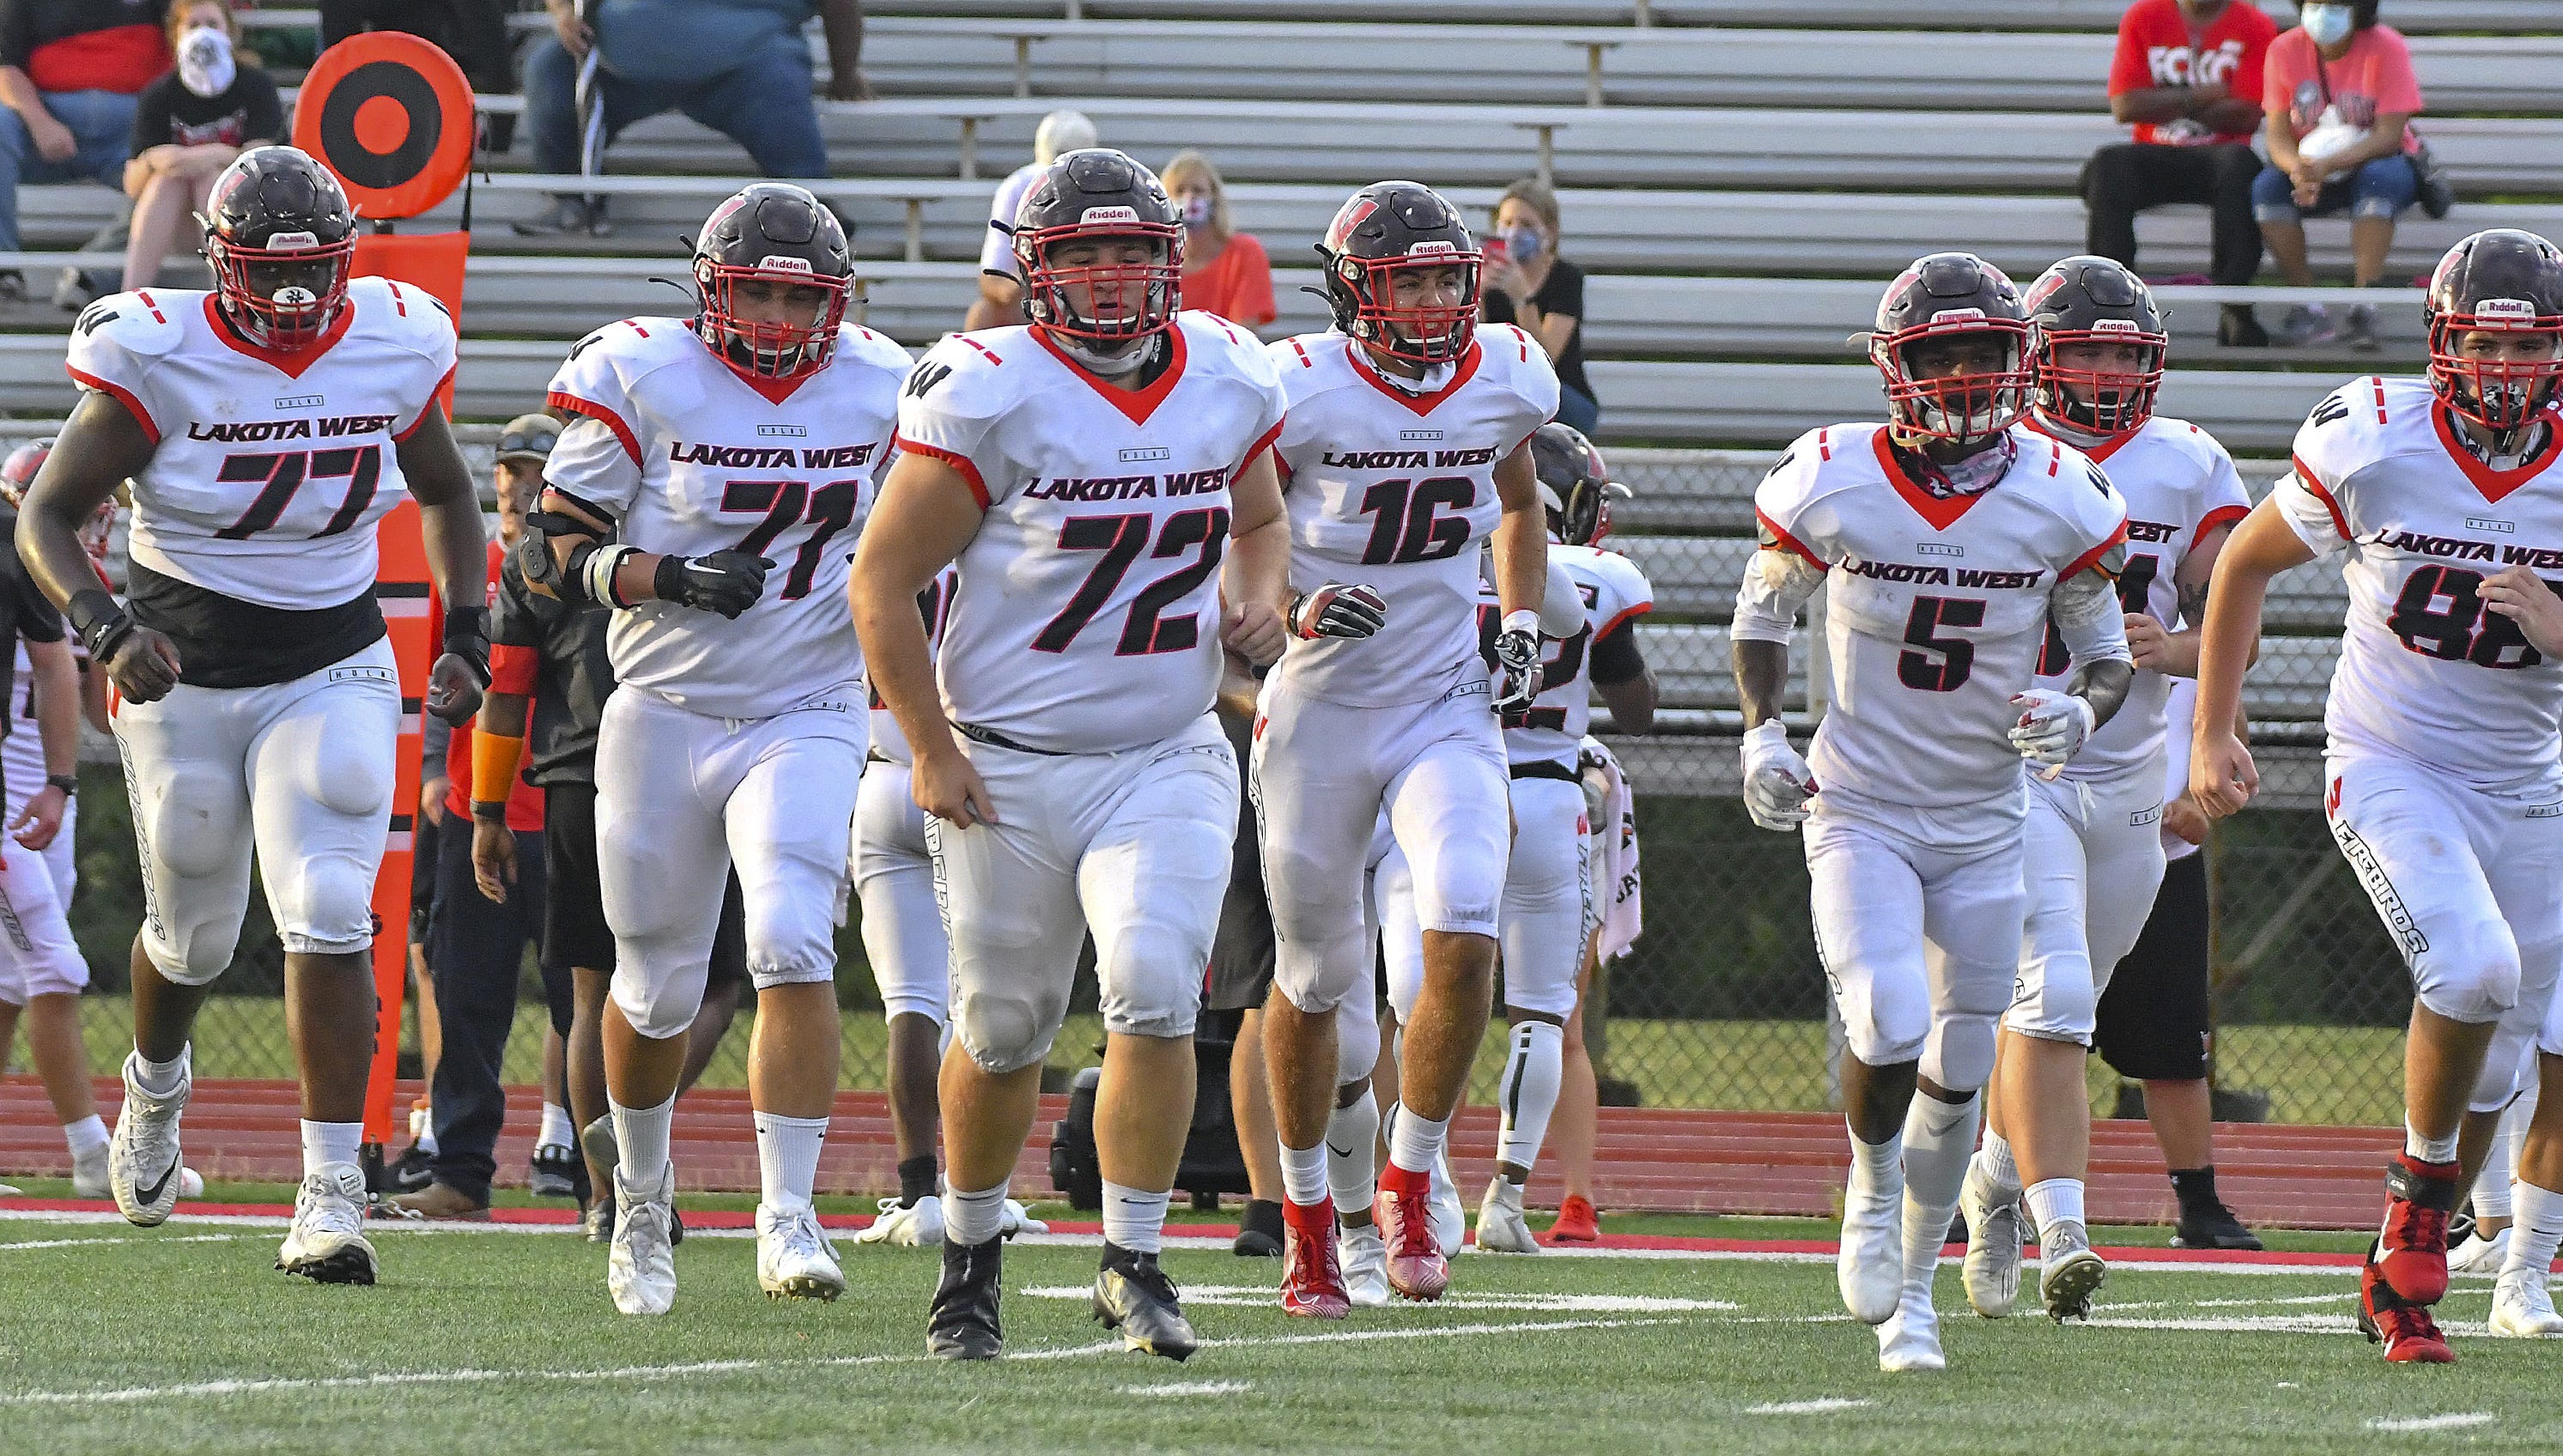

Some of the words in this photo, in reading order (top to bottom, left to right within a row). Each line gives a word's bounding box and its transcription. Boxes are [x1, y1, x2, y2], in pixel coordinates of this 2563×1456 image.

[767, 258, 807, 270] Riddell
[1416, 244, 1452, 254] Riddell
[2489, 301, 2522, 312] Riddell
[189, 420, 312, 442] LAKOTA
[317, 414, 399, 438] WEST
[670, 441, 797, 469] LAKOTA
[801, 441, 878, 469] WEST
[1322, 452, 1430, 469] LAKOTA
[1433, 444, 1501, 468] WEST
[216, 444, 380, 540] 77
[1023, 477, 1157, 501] LAKOTA
[1163, 464, 1230, 496] WEST
[1359, 476, 1476, 565] 16
[720, 480, 859, 601] 71
[2374, 529, 2496, 563] LAKOTA
[1029, 507, 1230, 656] 72
[1842, 555, 1948, 584] LAKOTA
[1954, 568, 2045, 589] WEST
[1897, 594, 1988, 692] 5
[2335, 819, 2430, 955] FIREBIRDS
